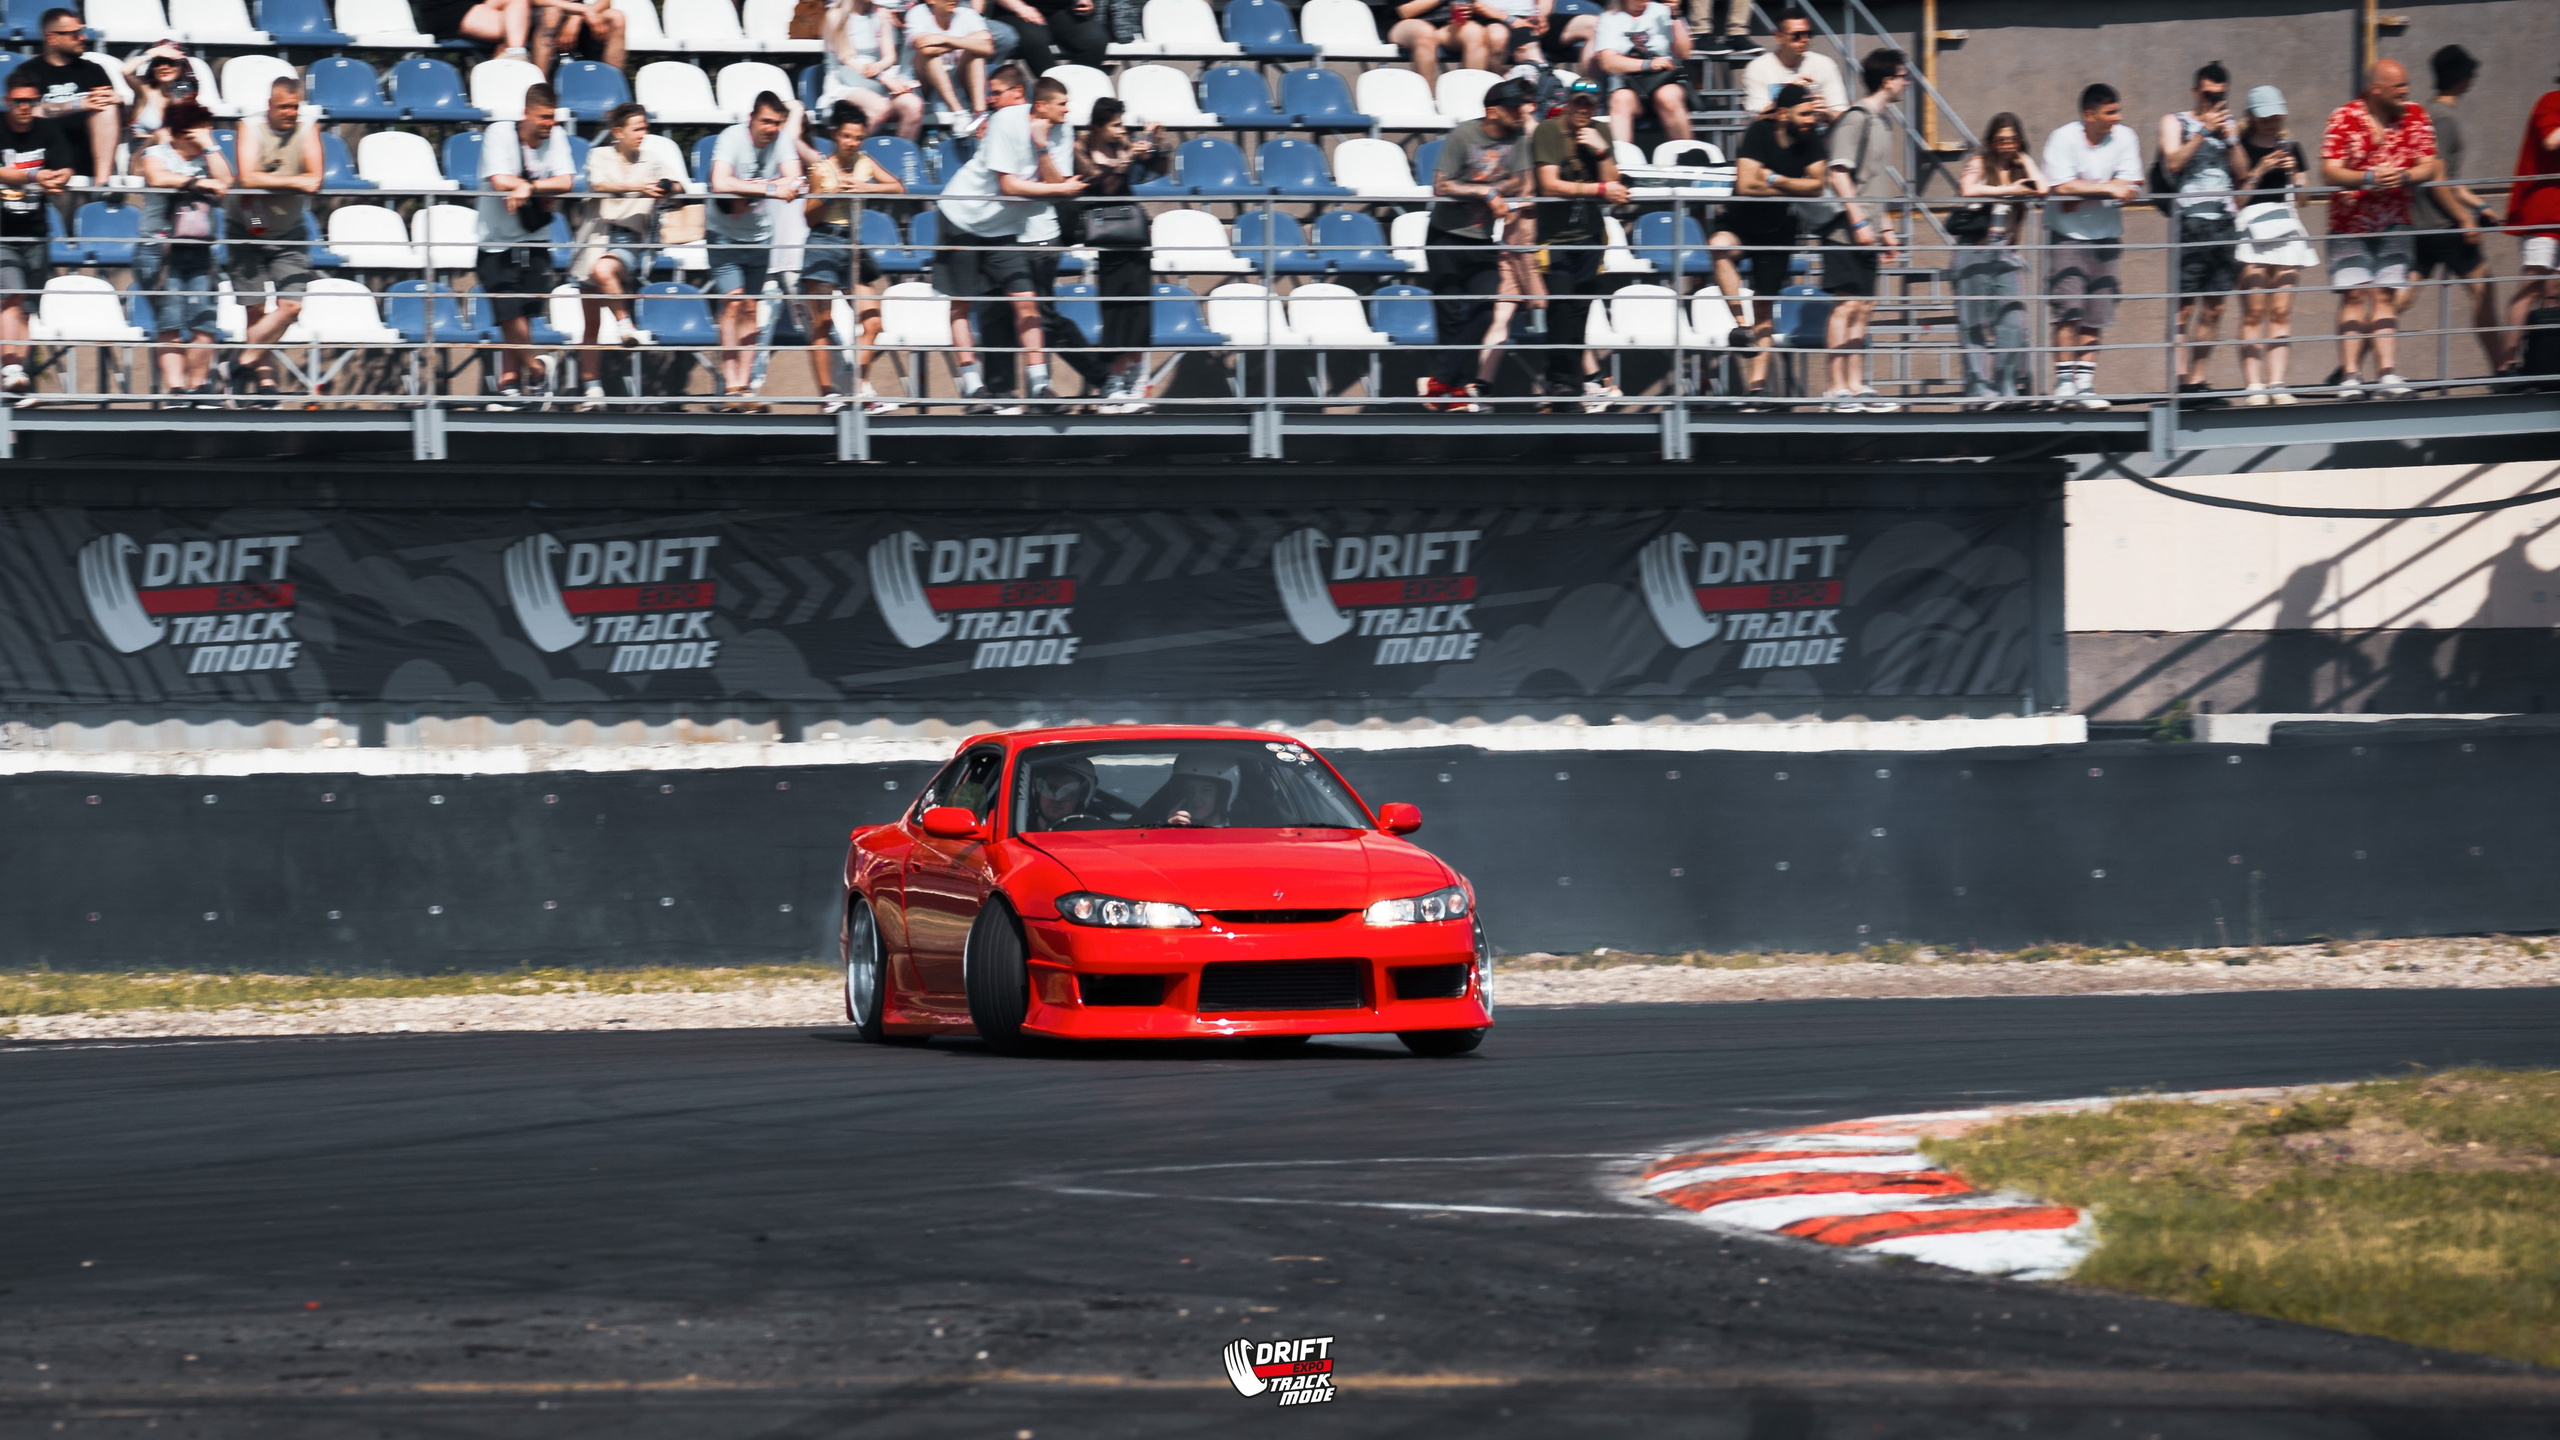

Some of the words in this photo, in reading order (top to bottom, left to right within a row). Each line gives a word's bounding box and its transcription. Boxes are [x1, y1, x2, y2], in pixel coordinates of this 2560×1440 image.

[141, 535, 302, 587] DRIFT
[565, 536, 721, 587] DRIFT
[928, 533, 1081, 584] DRIFT
[1331, 530, 1482, 580] DRIFT
[1698, 535, 1848, 585] DRIFT
[169, 611, 295, 644] TRACK
[592, 611, 714, 644] TRACK
[954, 608, 1074, 640] TRACK
[1357, 603, 1475, 636] TRACK
[1723, 609, 1841, 641] TRACK
[186, 641, 302, 674] MODE
[607, 640, 721, 673] MODE
[971, 637, 1082, 670] MODE
[1373, 632, 1484, 665] MODE
[1739, 637, 1848, 669] MODE
